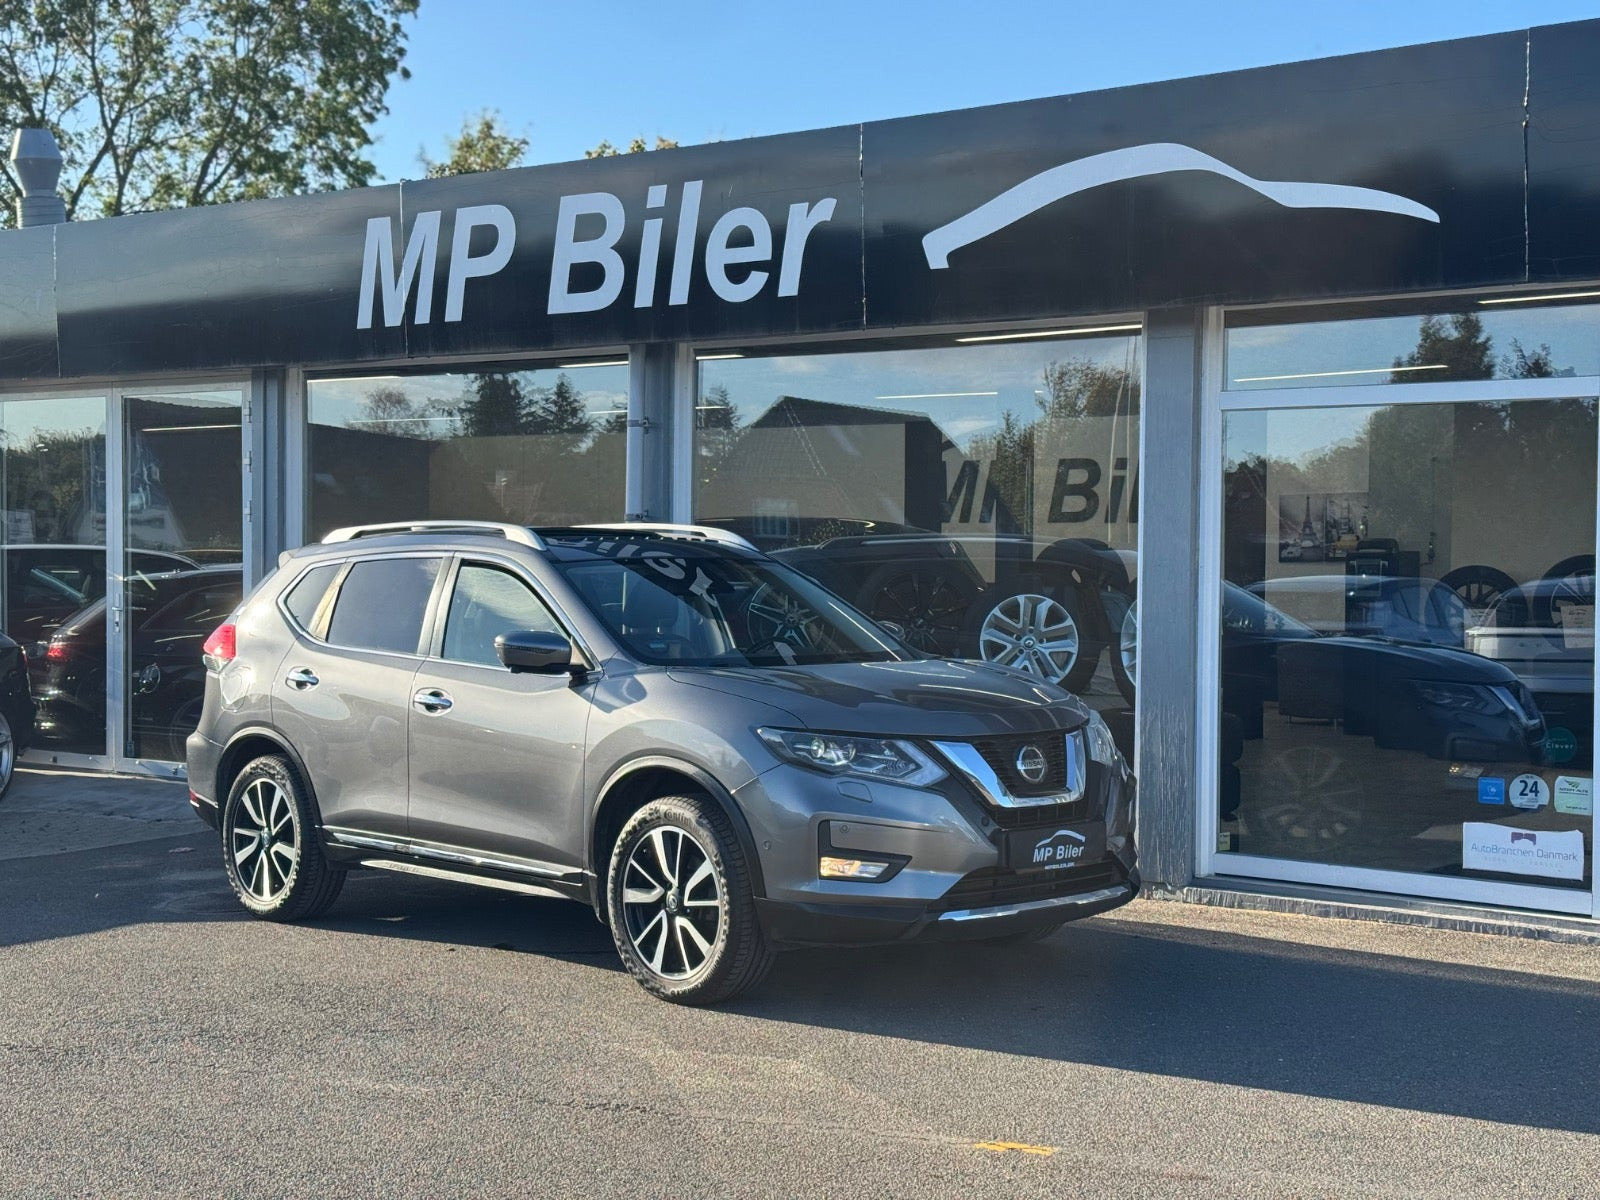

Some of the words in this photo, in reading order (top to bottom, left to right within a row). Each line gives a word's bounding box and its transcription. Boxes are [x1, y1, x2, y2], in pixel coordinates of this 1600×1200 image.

[356, 204, 517, 330] MP
[547, 179, 837, 315] Biler
[1519, 779, 1540, 797] 24
[1033, 847, 1053, 862] MP
[1056, 844, 1084, 859] Biler
[1471, 843, 1534, 857] AutoBranchen
[1536, 848, 1578, 861] Danmark
